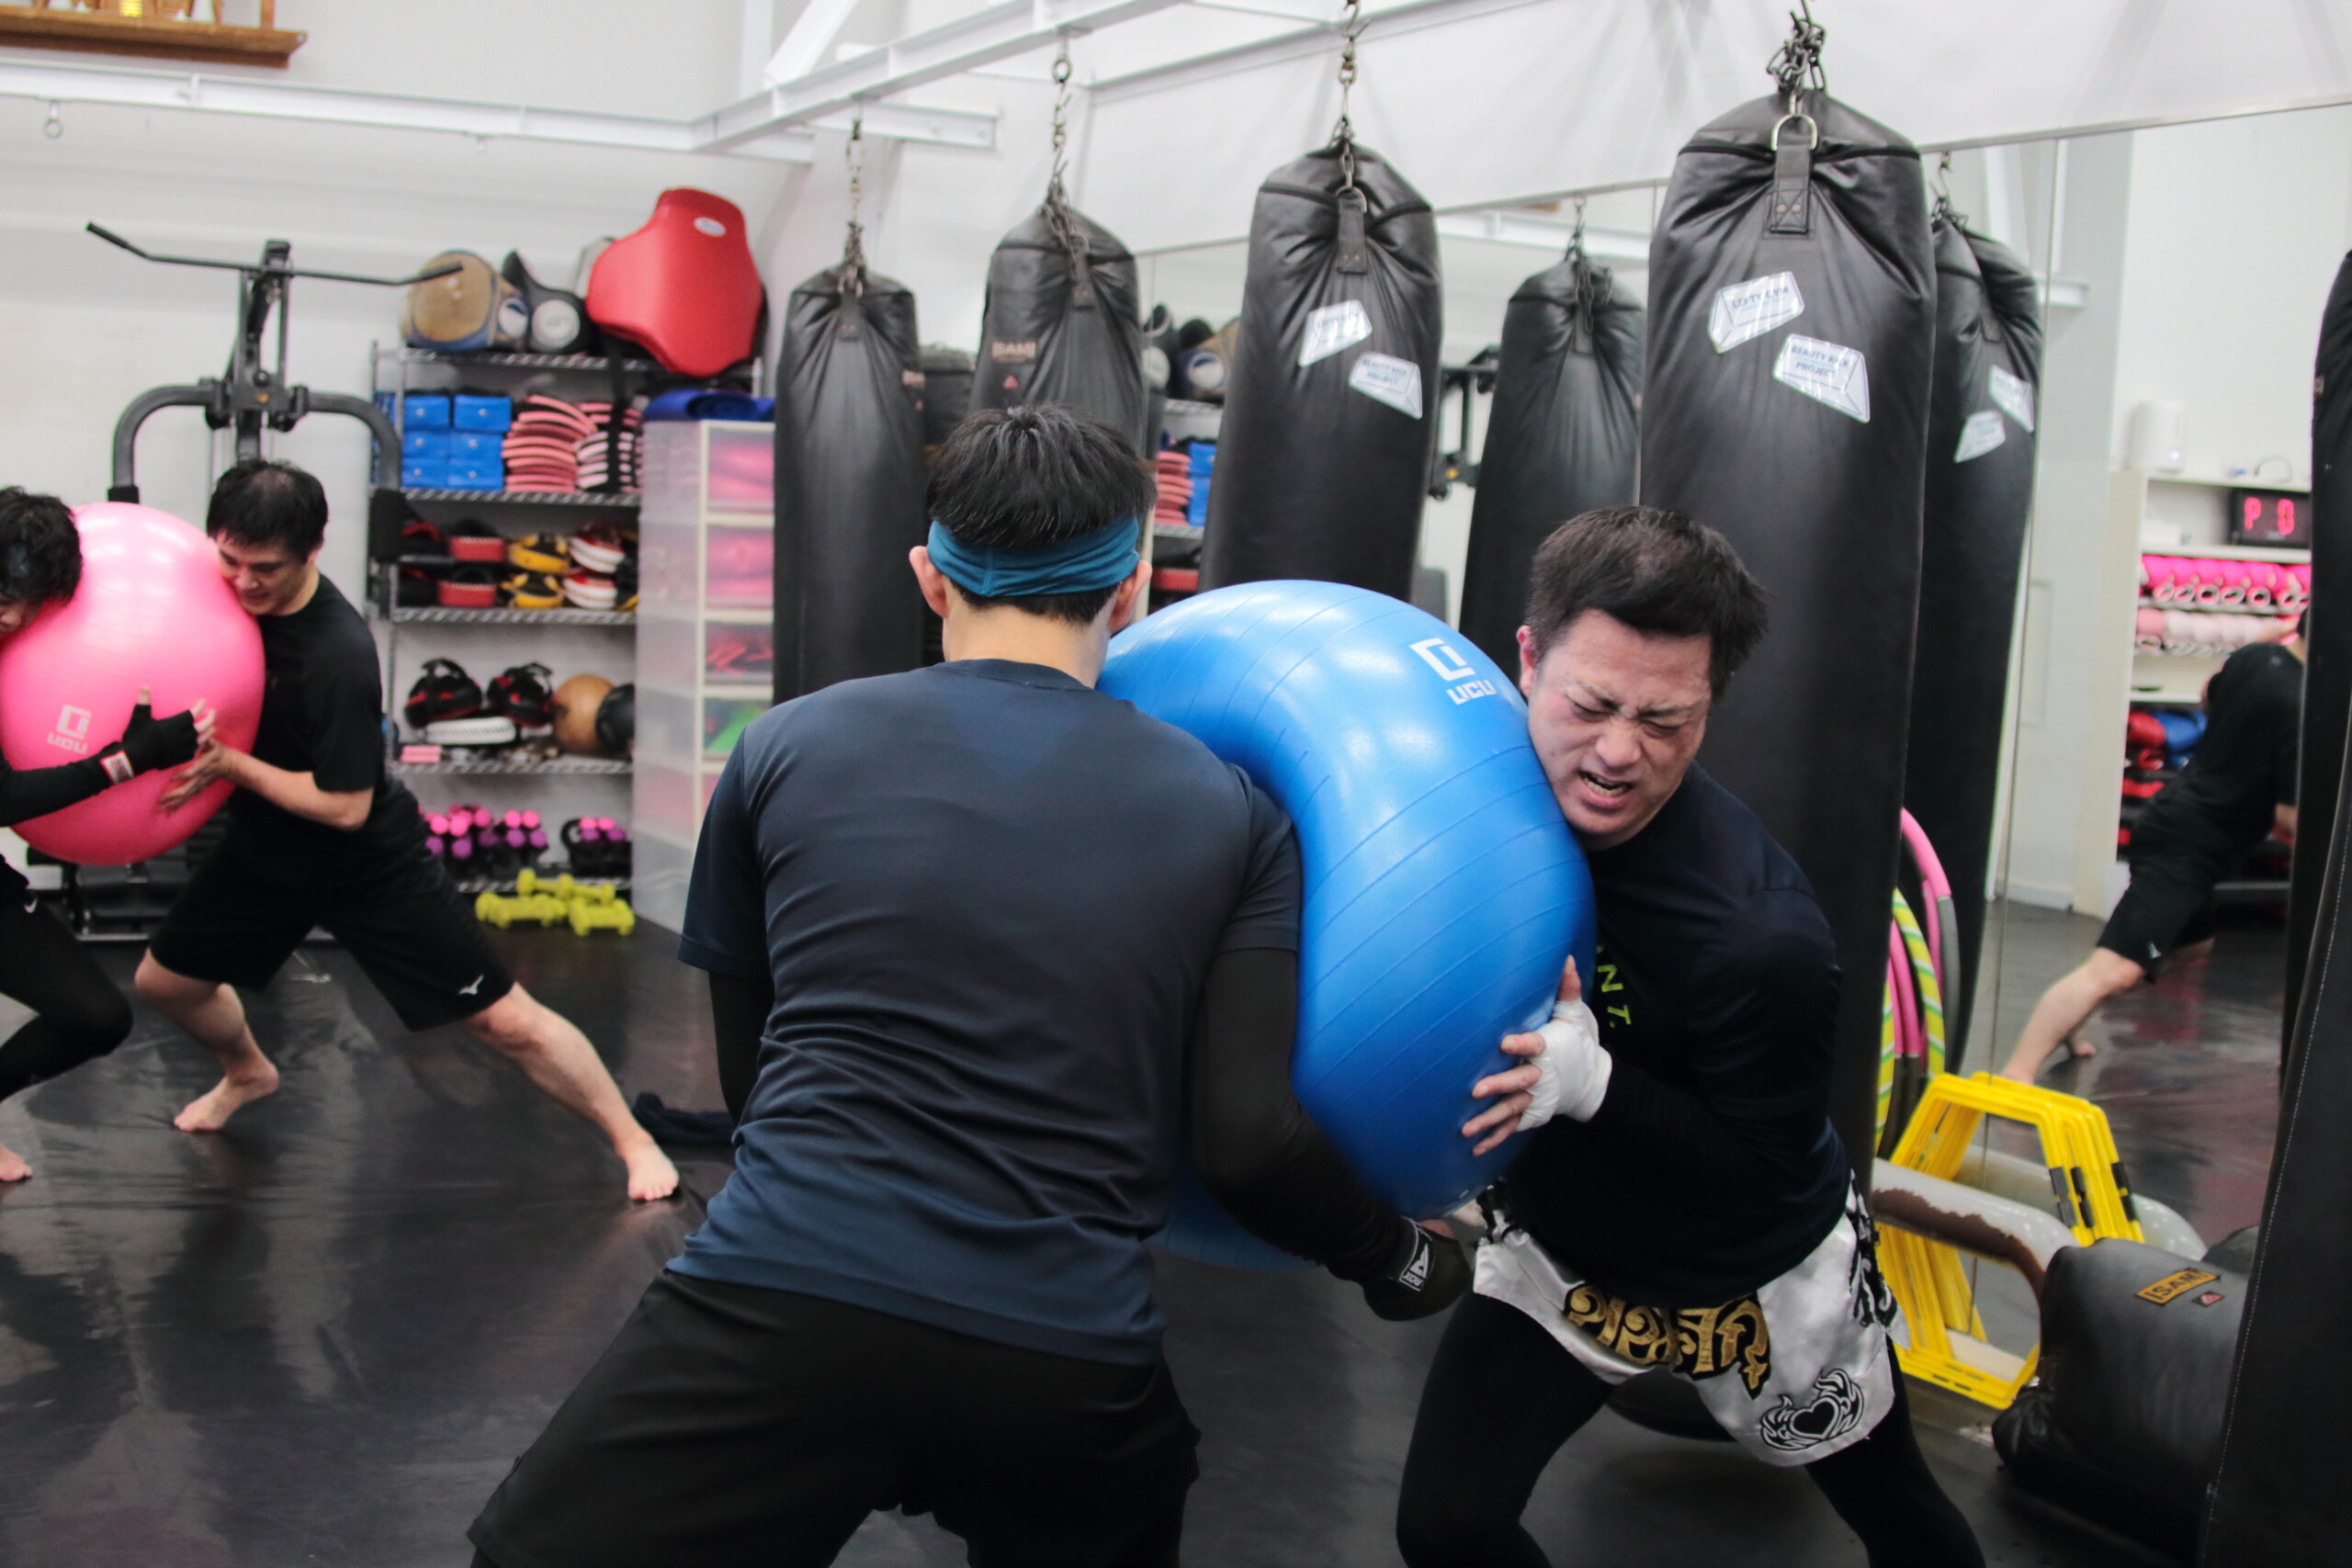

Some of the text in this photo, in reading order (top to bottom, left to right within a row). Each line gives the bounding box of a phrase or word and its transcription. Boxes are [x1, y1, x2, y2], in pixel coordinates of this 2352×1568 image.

[1792, 344, 1849, 367] BEAUTY KICK
[1795, 361, 1837, 378] PROJECT
